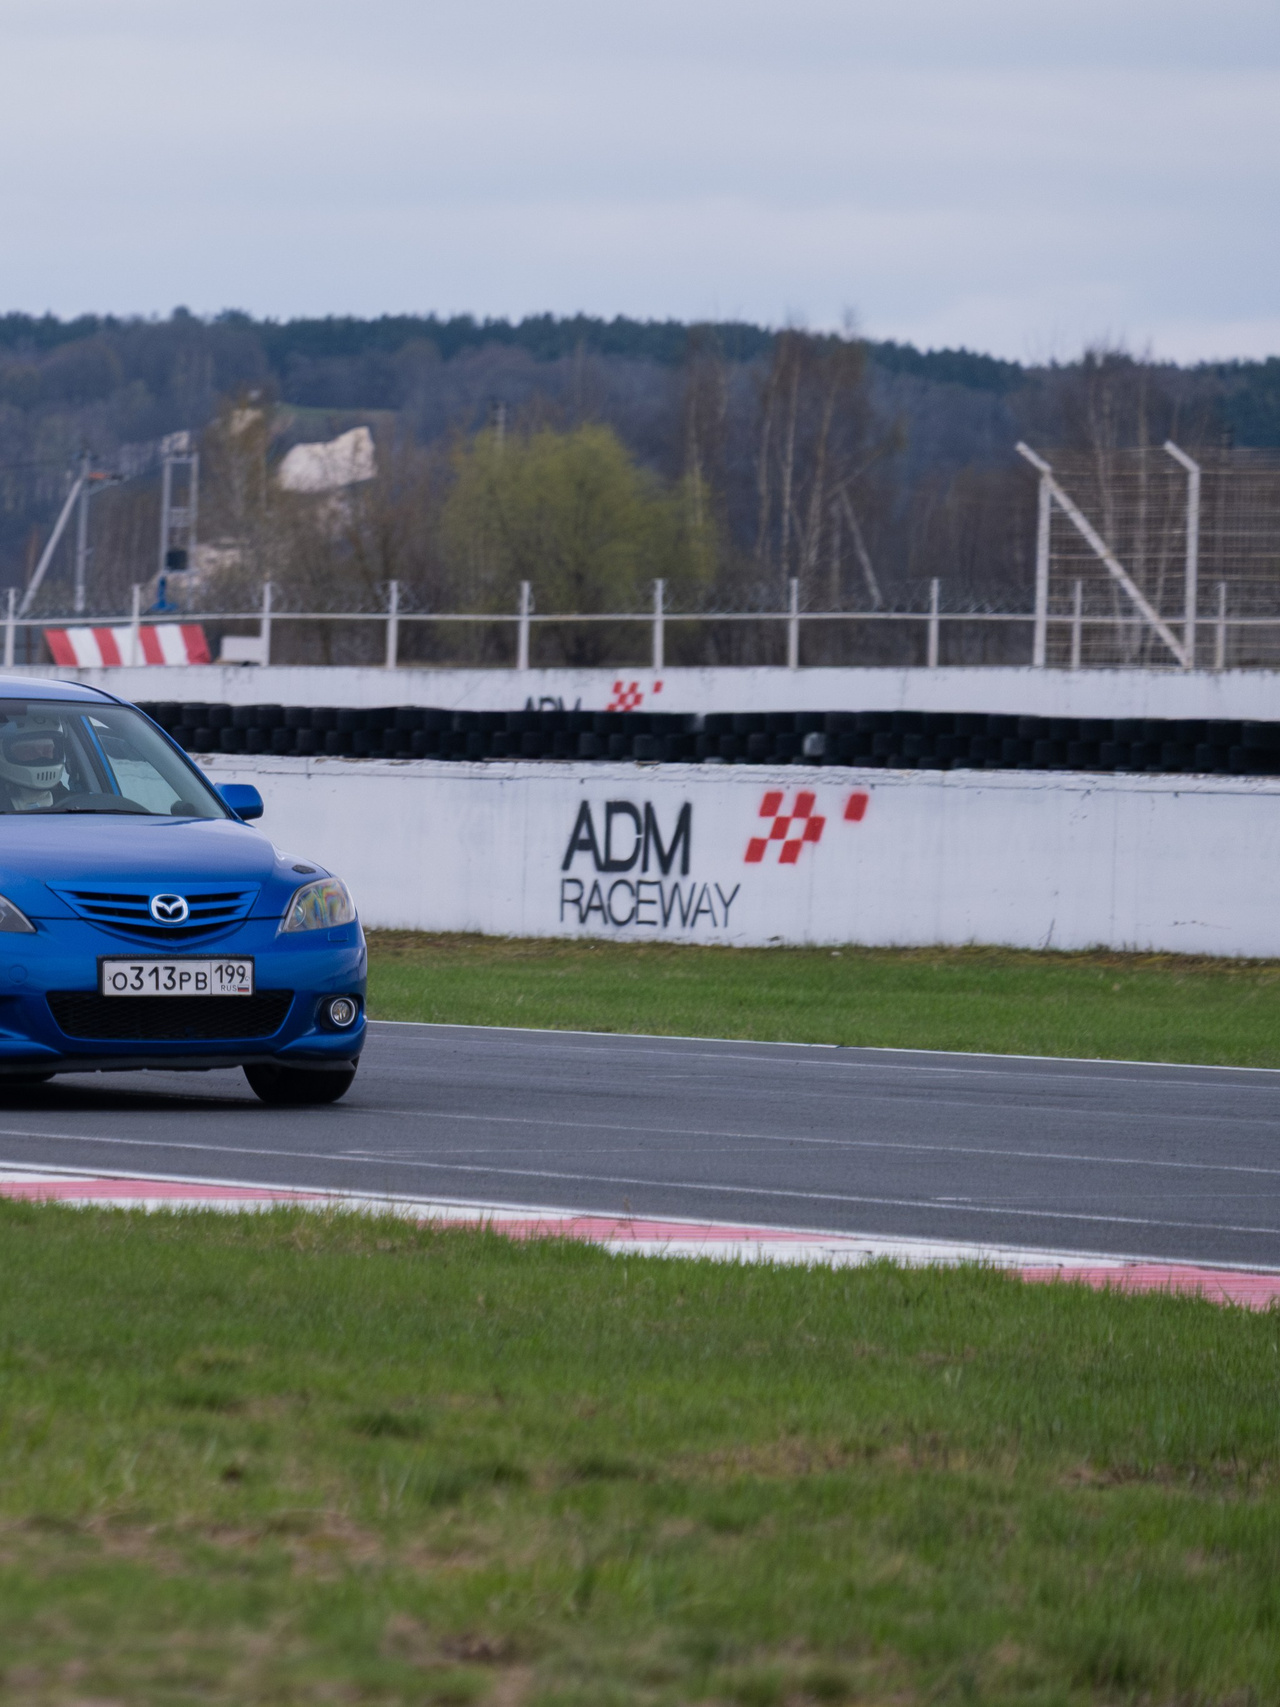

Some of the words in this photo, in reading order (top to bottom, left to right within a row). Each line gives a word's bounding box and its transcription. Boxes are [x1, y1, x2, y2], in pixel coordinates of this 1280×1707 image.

[561, 799, 692, 876] ADM
[560, 878, 741, 928] RACEWAY
[214, 965, 246, 984] 199
[220, 984, 237, 992] RUS
